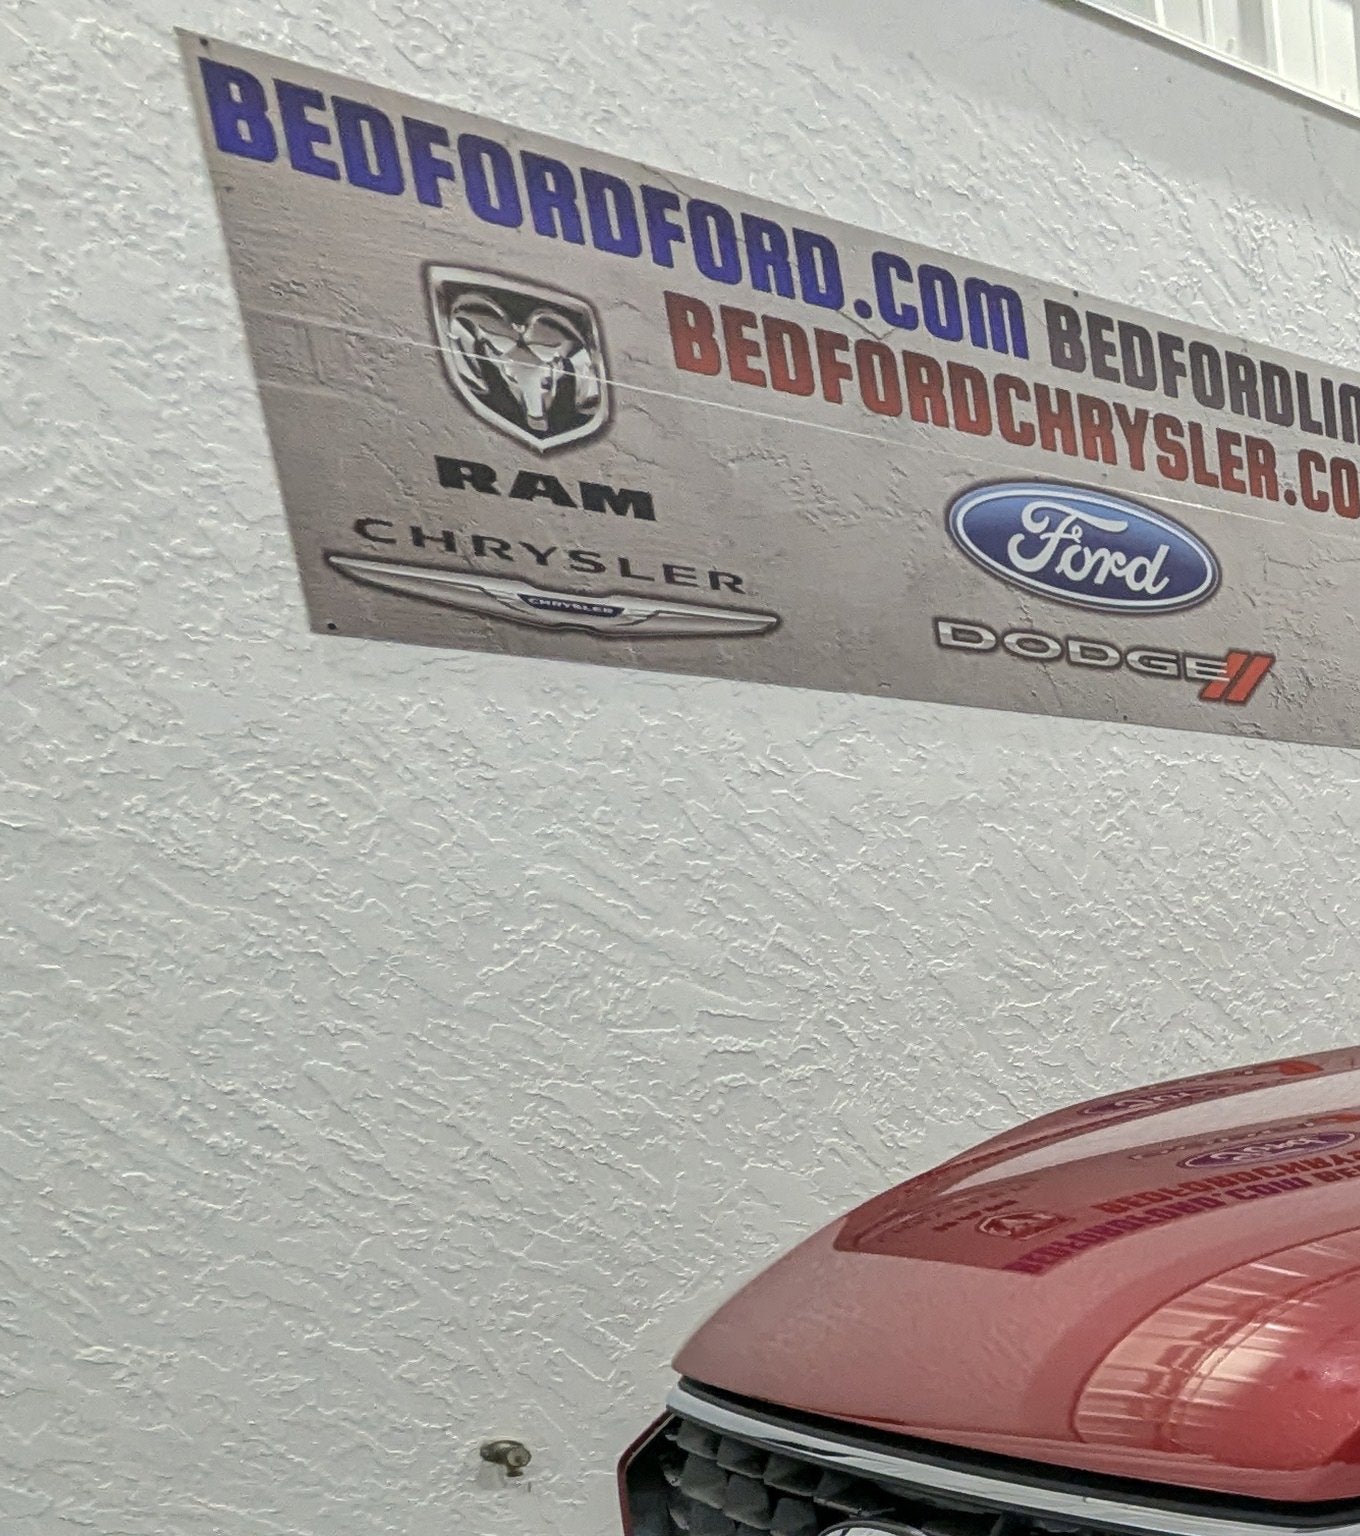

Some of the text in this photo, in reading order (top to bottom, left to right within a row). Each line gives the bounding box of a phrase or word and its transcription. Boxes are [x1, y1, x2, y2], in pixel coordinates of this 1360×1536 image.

[198, 56, 1030, 360] BEDFORDFORD.COM
[434, 455, 656, 522] RAM
[353, 517, 746, 595] CHRYSLER
[1006, 500, 1170, 596] Ford
[932, 617, 1231, 682] DODGE
